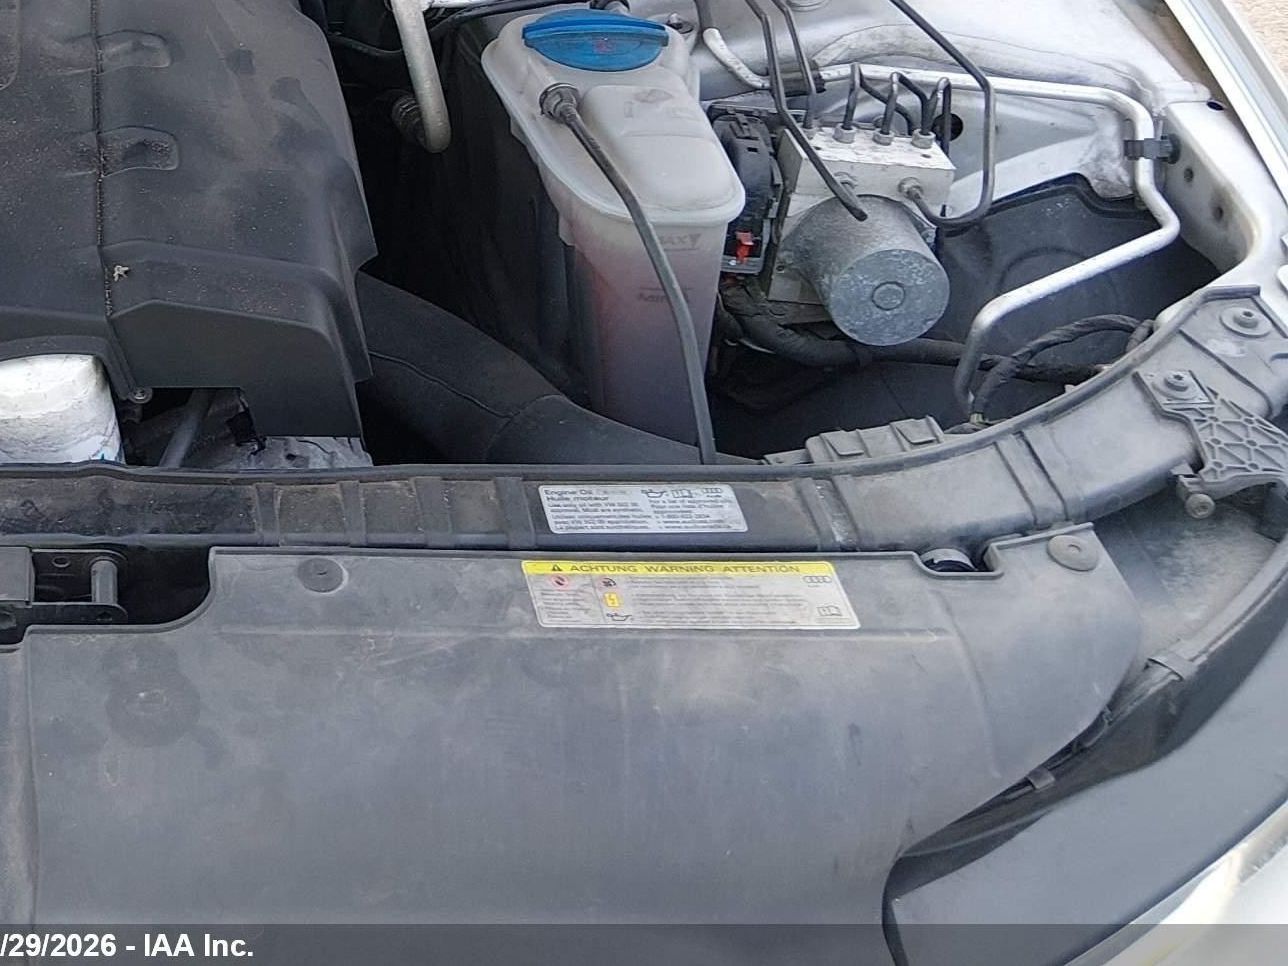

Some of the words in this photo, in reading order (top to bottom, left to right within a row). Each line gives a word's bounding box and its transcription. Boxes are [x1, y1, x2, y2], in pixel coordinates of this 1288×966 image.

[570, 565, 638, 573] ACHTUNG
[645, 565, 714, 573] WARNING
[721, 565, 801, 573] ATTENTION
